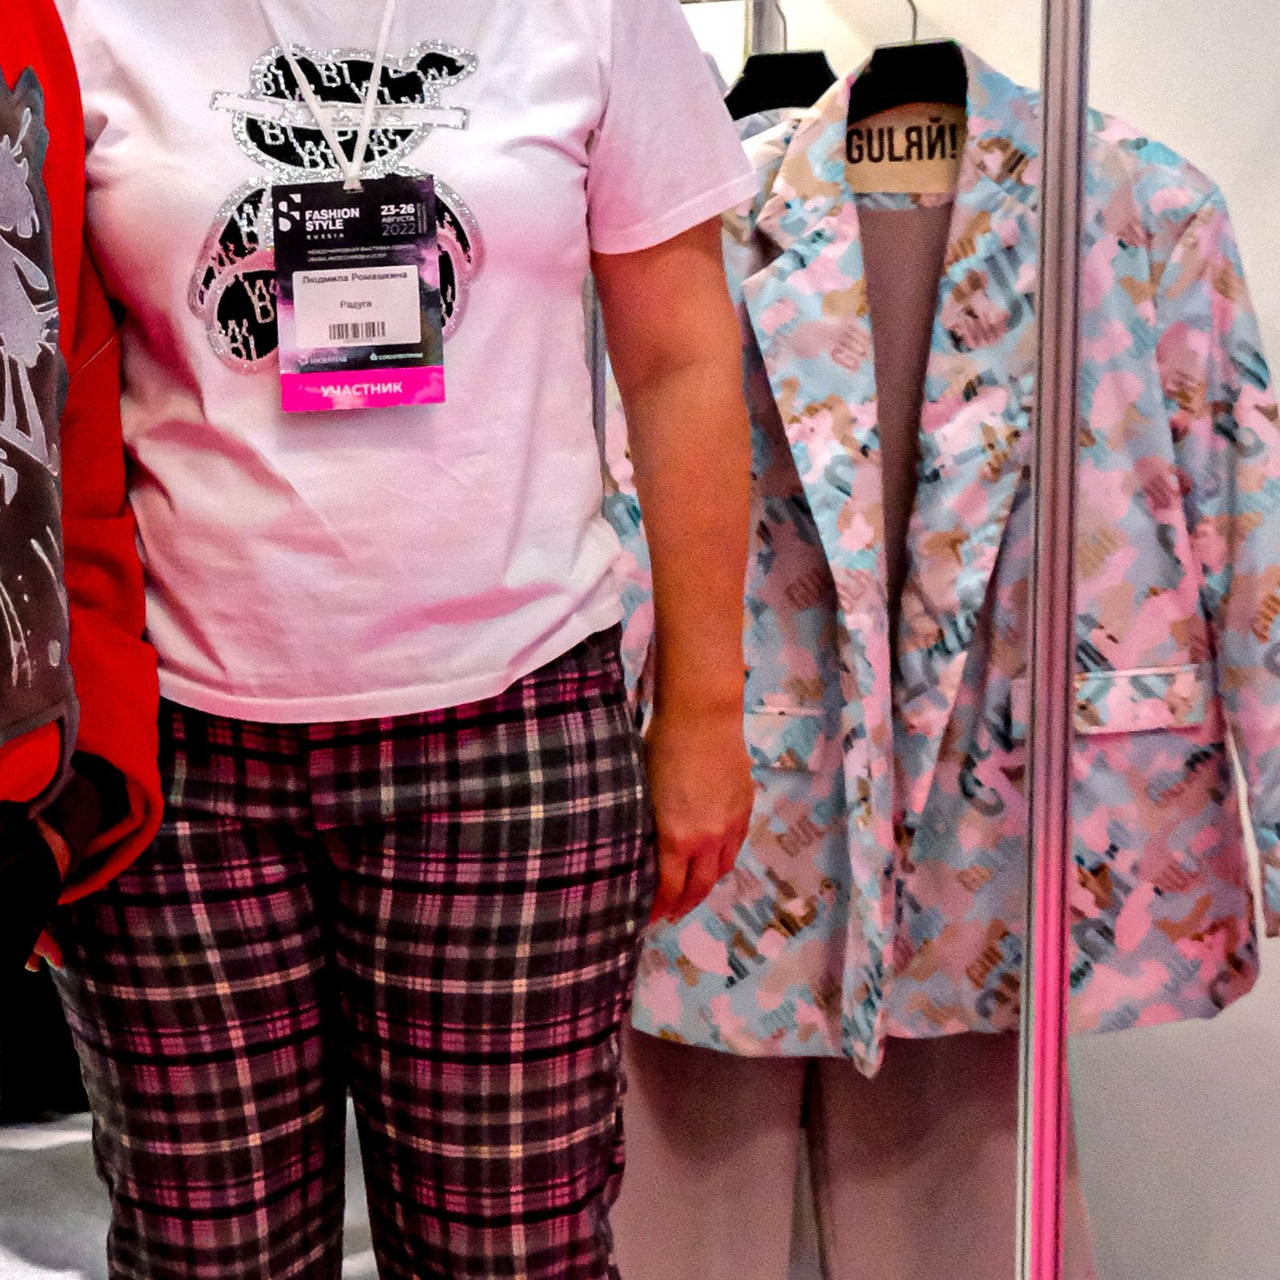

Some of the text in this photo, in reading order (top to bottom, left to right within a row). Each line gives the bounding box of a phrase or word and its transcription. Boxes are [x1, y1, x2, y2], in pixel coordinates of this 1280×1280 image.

[305, 208, 360, 220] FASHION
[380, 204, 415, 216] 23-26
[305, 220, 344, 231] STYLE
[381, 224, 417, 236] 2022
[321, 381, 403, 397] УЧАСТНИК
